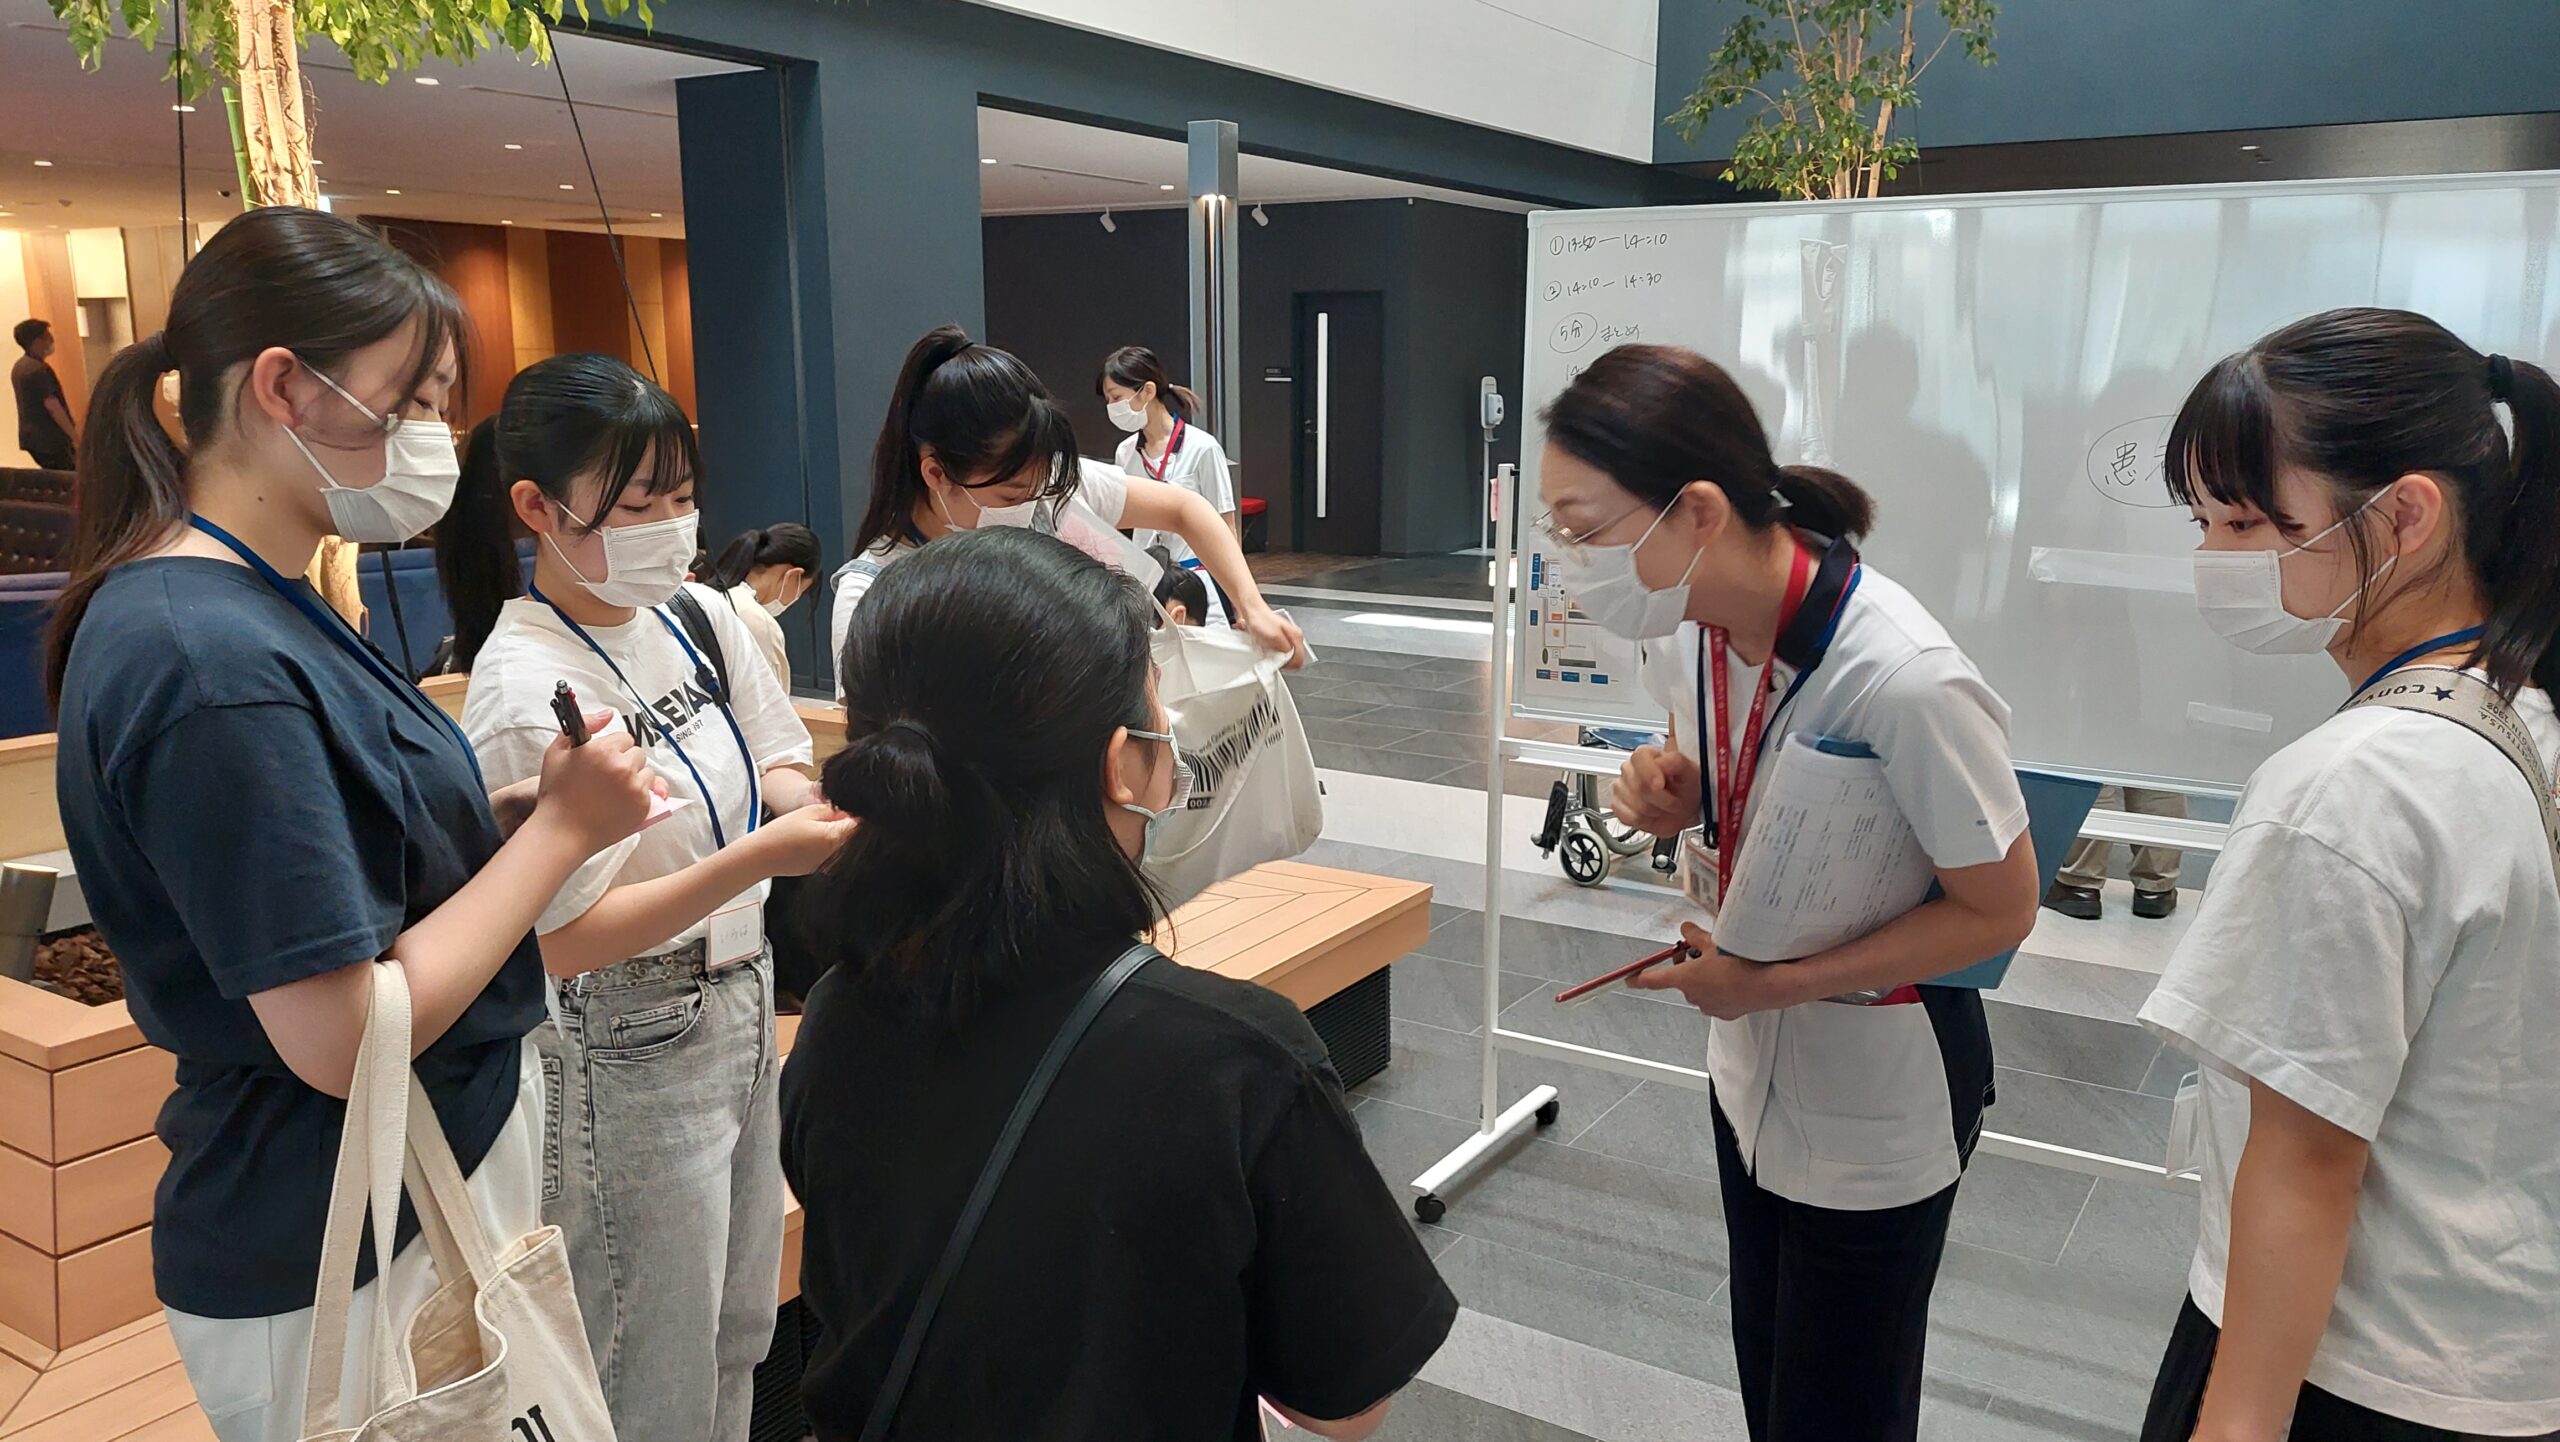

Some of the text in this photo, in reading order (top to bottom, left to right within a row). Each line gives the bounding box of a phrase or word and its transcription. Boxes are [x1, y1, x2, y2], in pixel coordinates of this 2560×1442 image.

[1624, 272, 1662, 288] 14:30
[1601, 323, 1640, 342] まとめ
